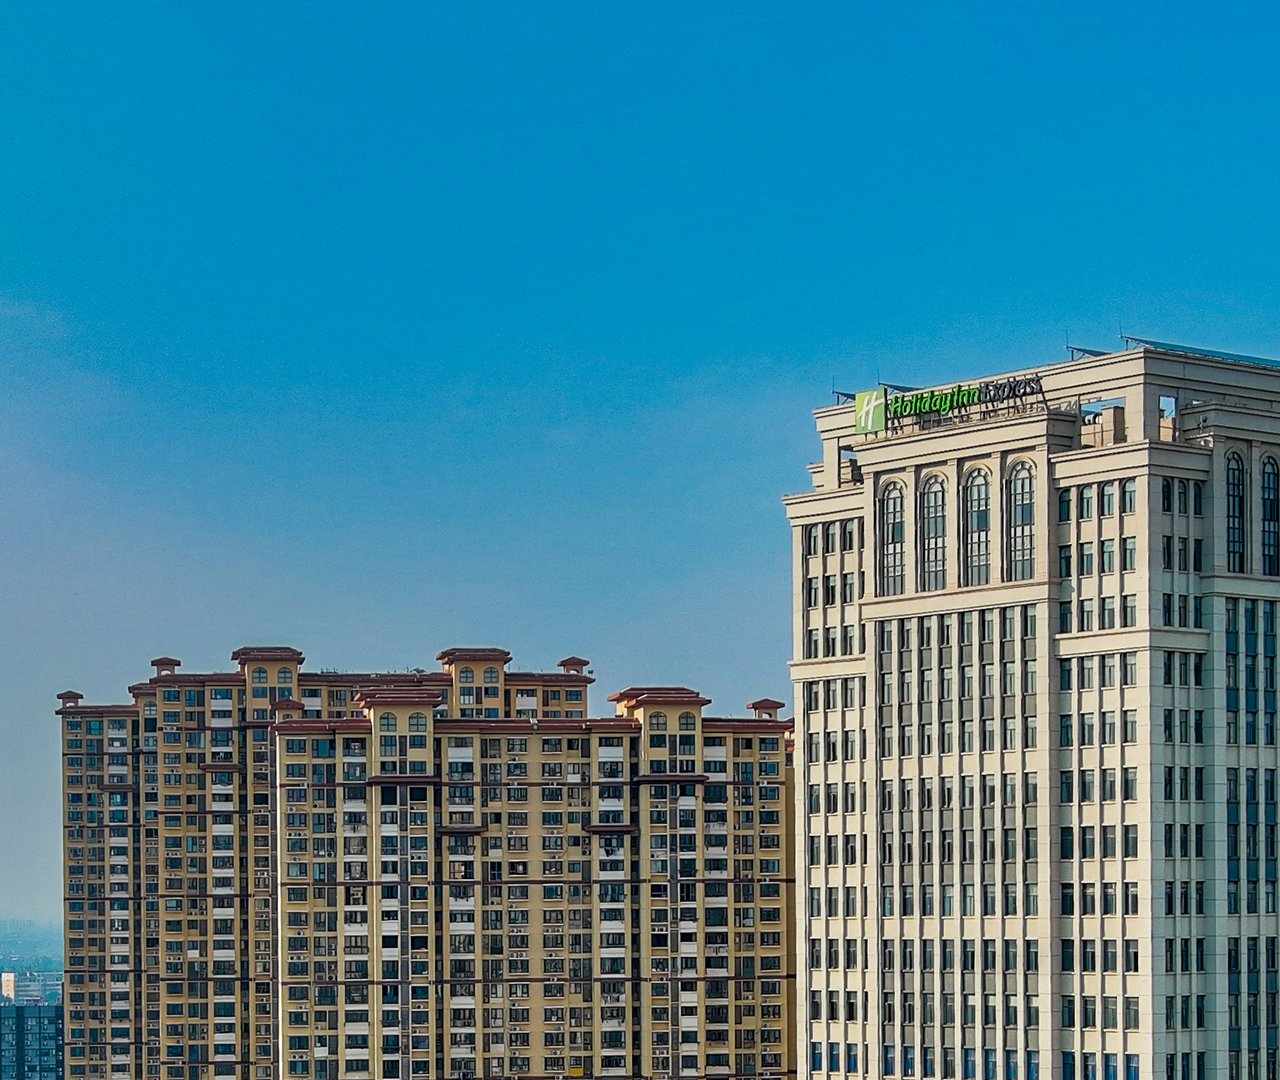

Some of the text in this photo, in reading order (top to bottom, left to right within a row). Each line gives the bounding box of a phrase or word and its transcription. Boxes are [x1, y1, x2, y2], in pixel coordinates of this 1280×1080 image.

[890, 390, 951, 416] Holiday
[951, 384, 981, 408] Inn
[980, 376, 1044, 402] Express
